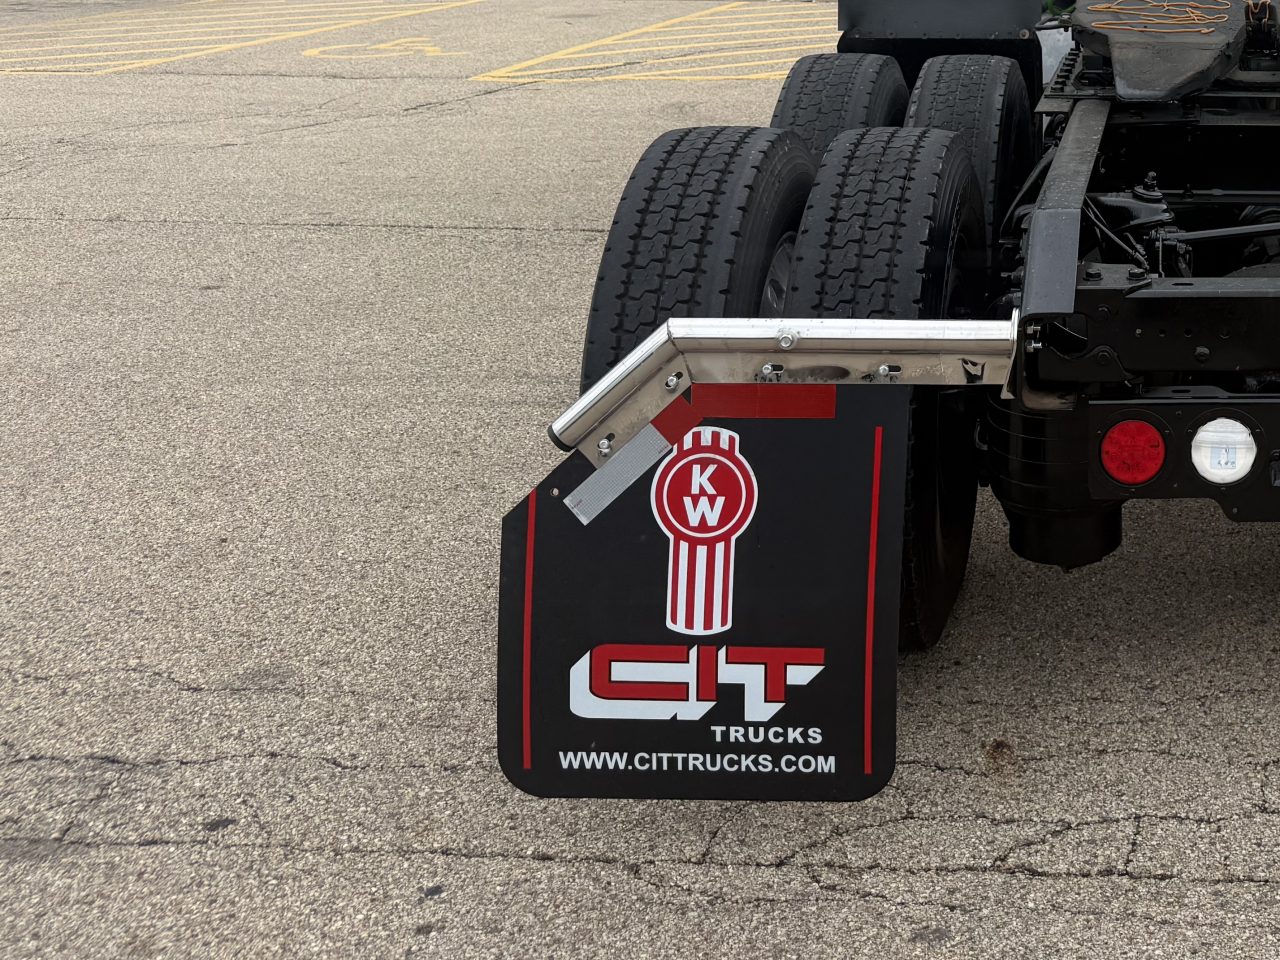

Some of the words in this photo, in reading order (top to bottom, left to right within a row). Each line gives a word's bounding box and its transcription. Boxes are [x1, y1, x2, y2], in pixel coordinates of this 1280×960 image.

[691, 464, 718, 495] K
[682, 496, 726, 527] W
[569, 644, 826, 721] CIT
[710, 725, 823, 744] TRUCKS
[558, 750, 836, 774] WWW.CITTRUCKS.COM
